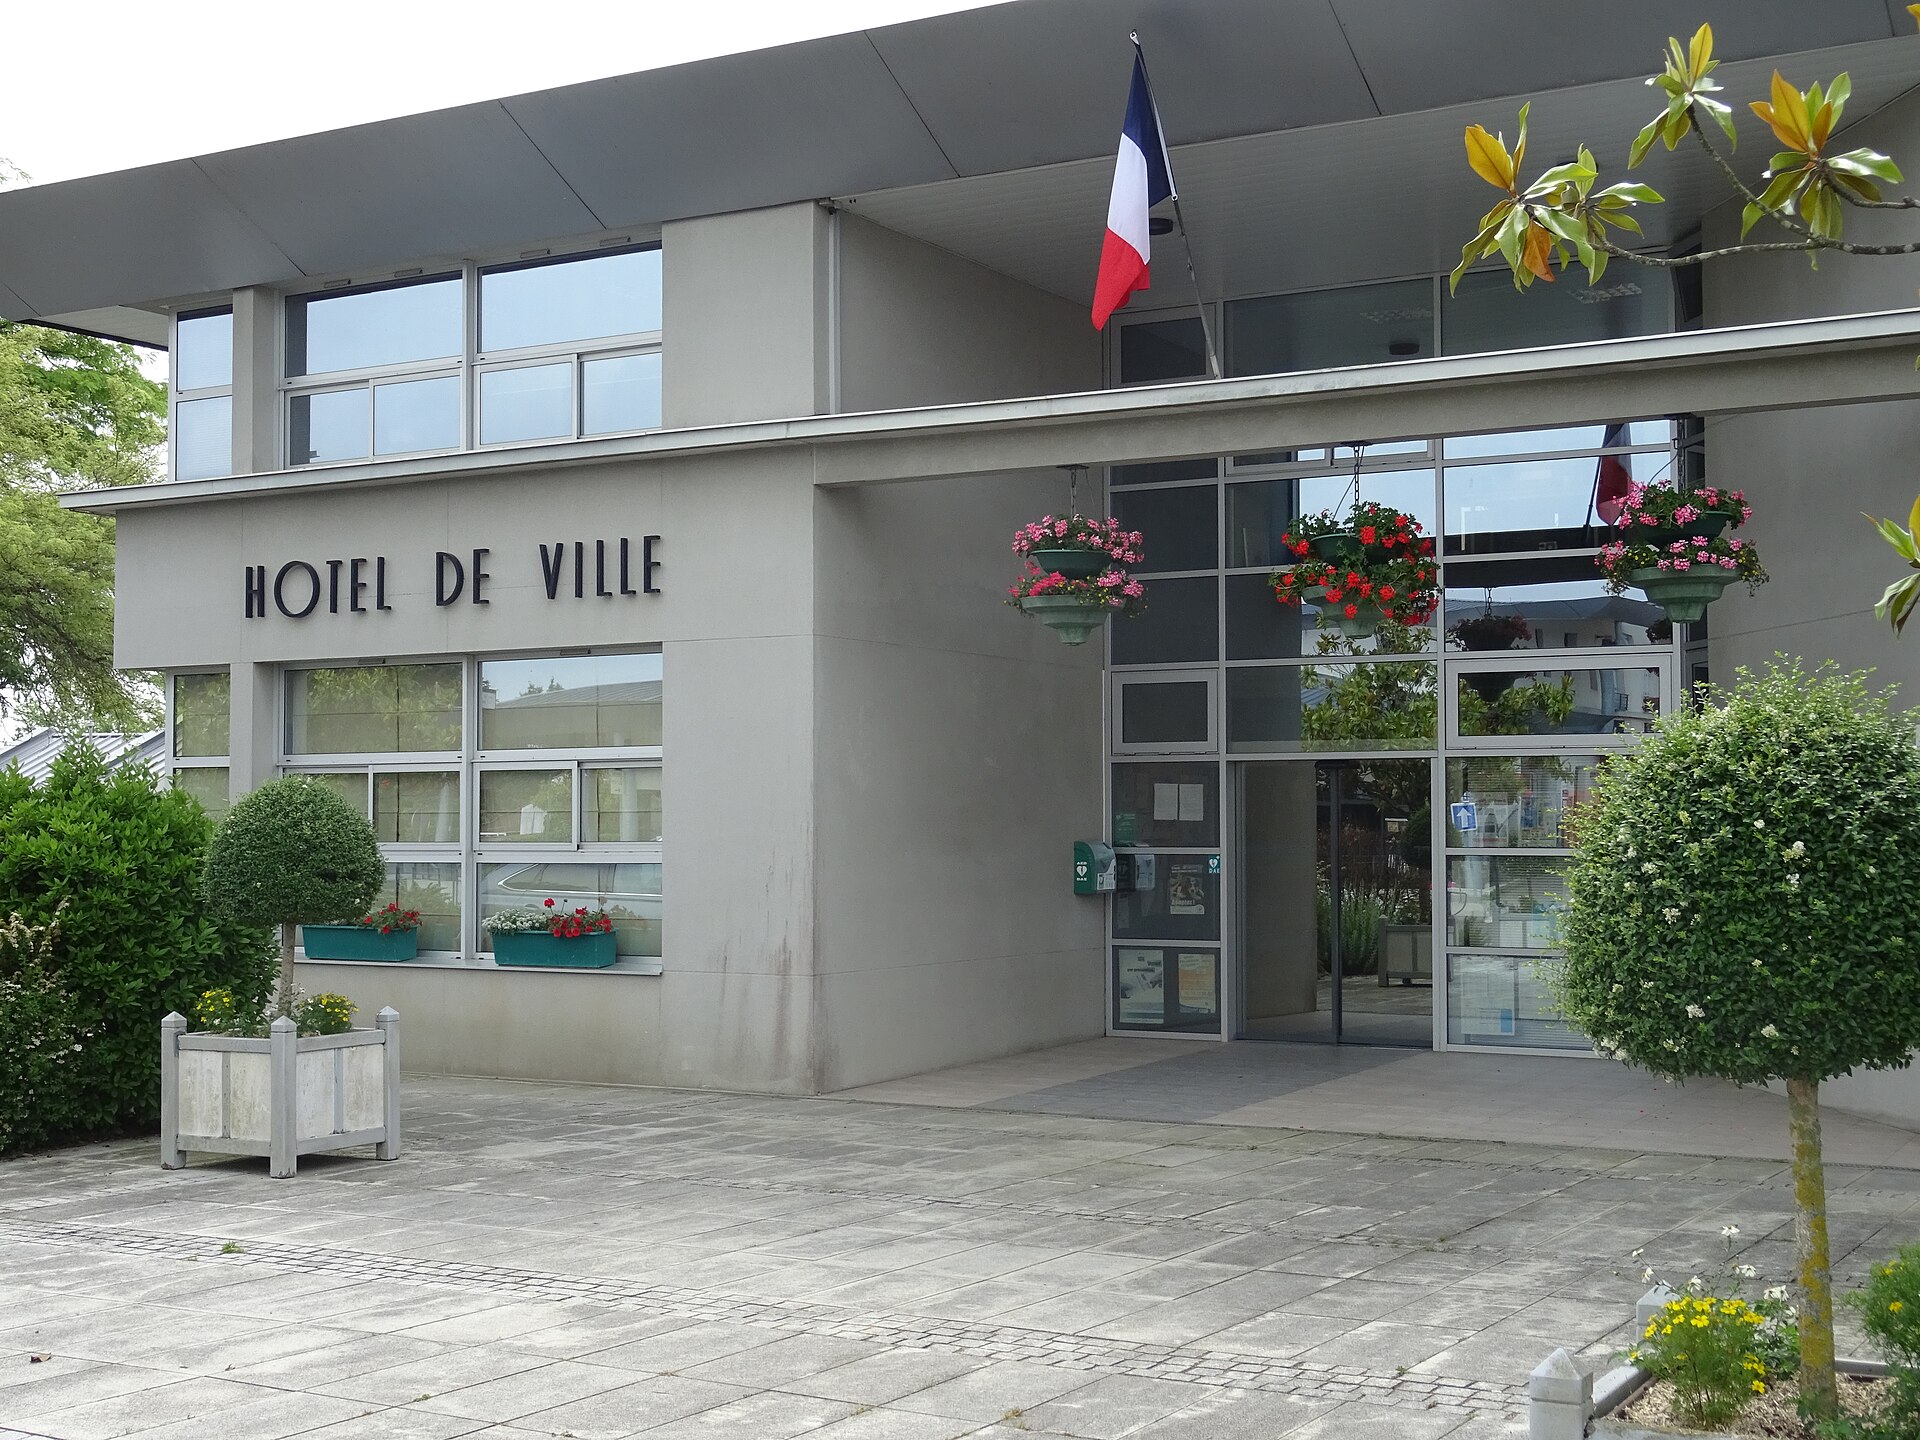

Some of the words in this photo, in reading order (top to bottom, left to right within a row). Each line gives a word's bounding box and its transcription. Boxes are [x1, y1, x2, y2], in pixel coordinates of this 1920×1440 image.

[245, 556, 392, 619] HOTEL
[435, 548, 490, 607] DE
[539, 535, 661, 600] VILLE
